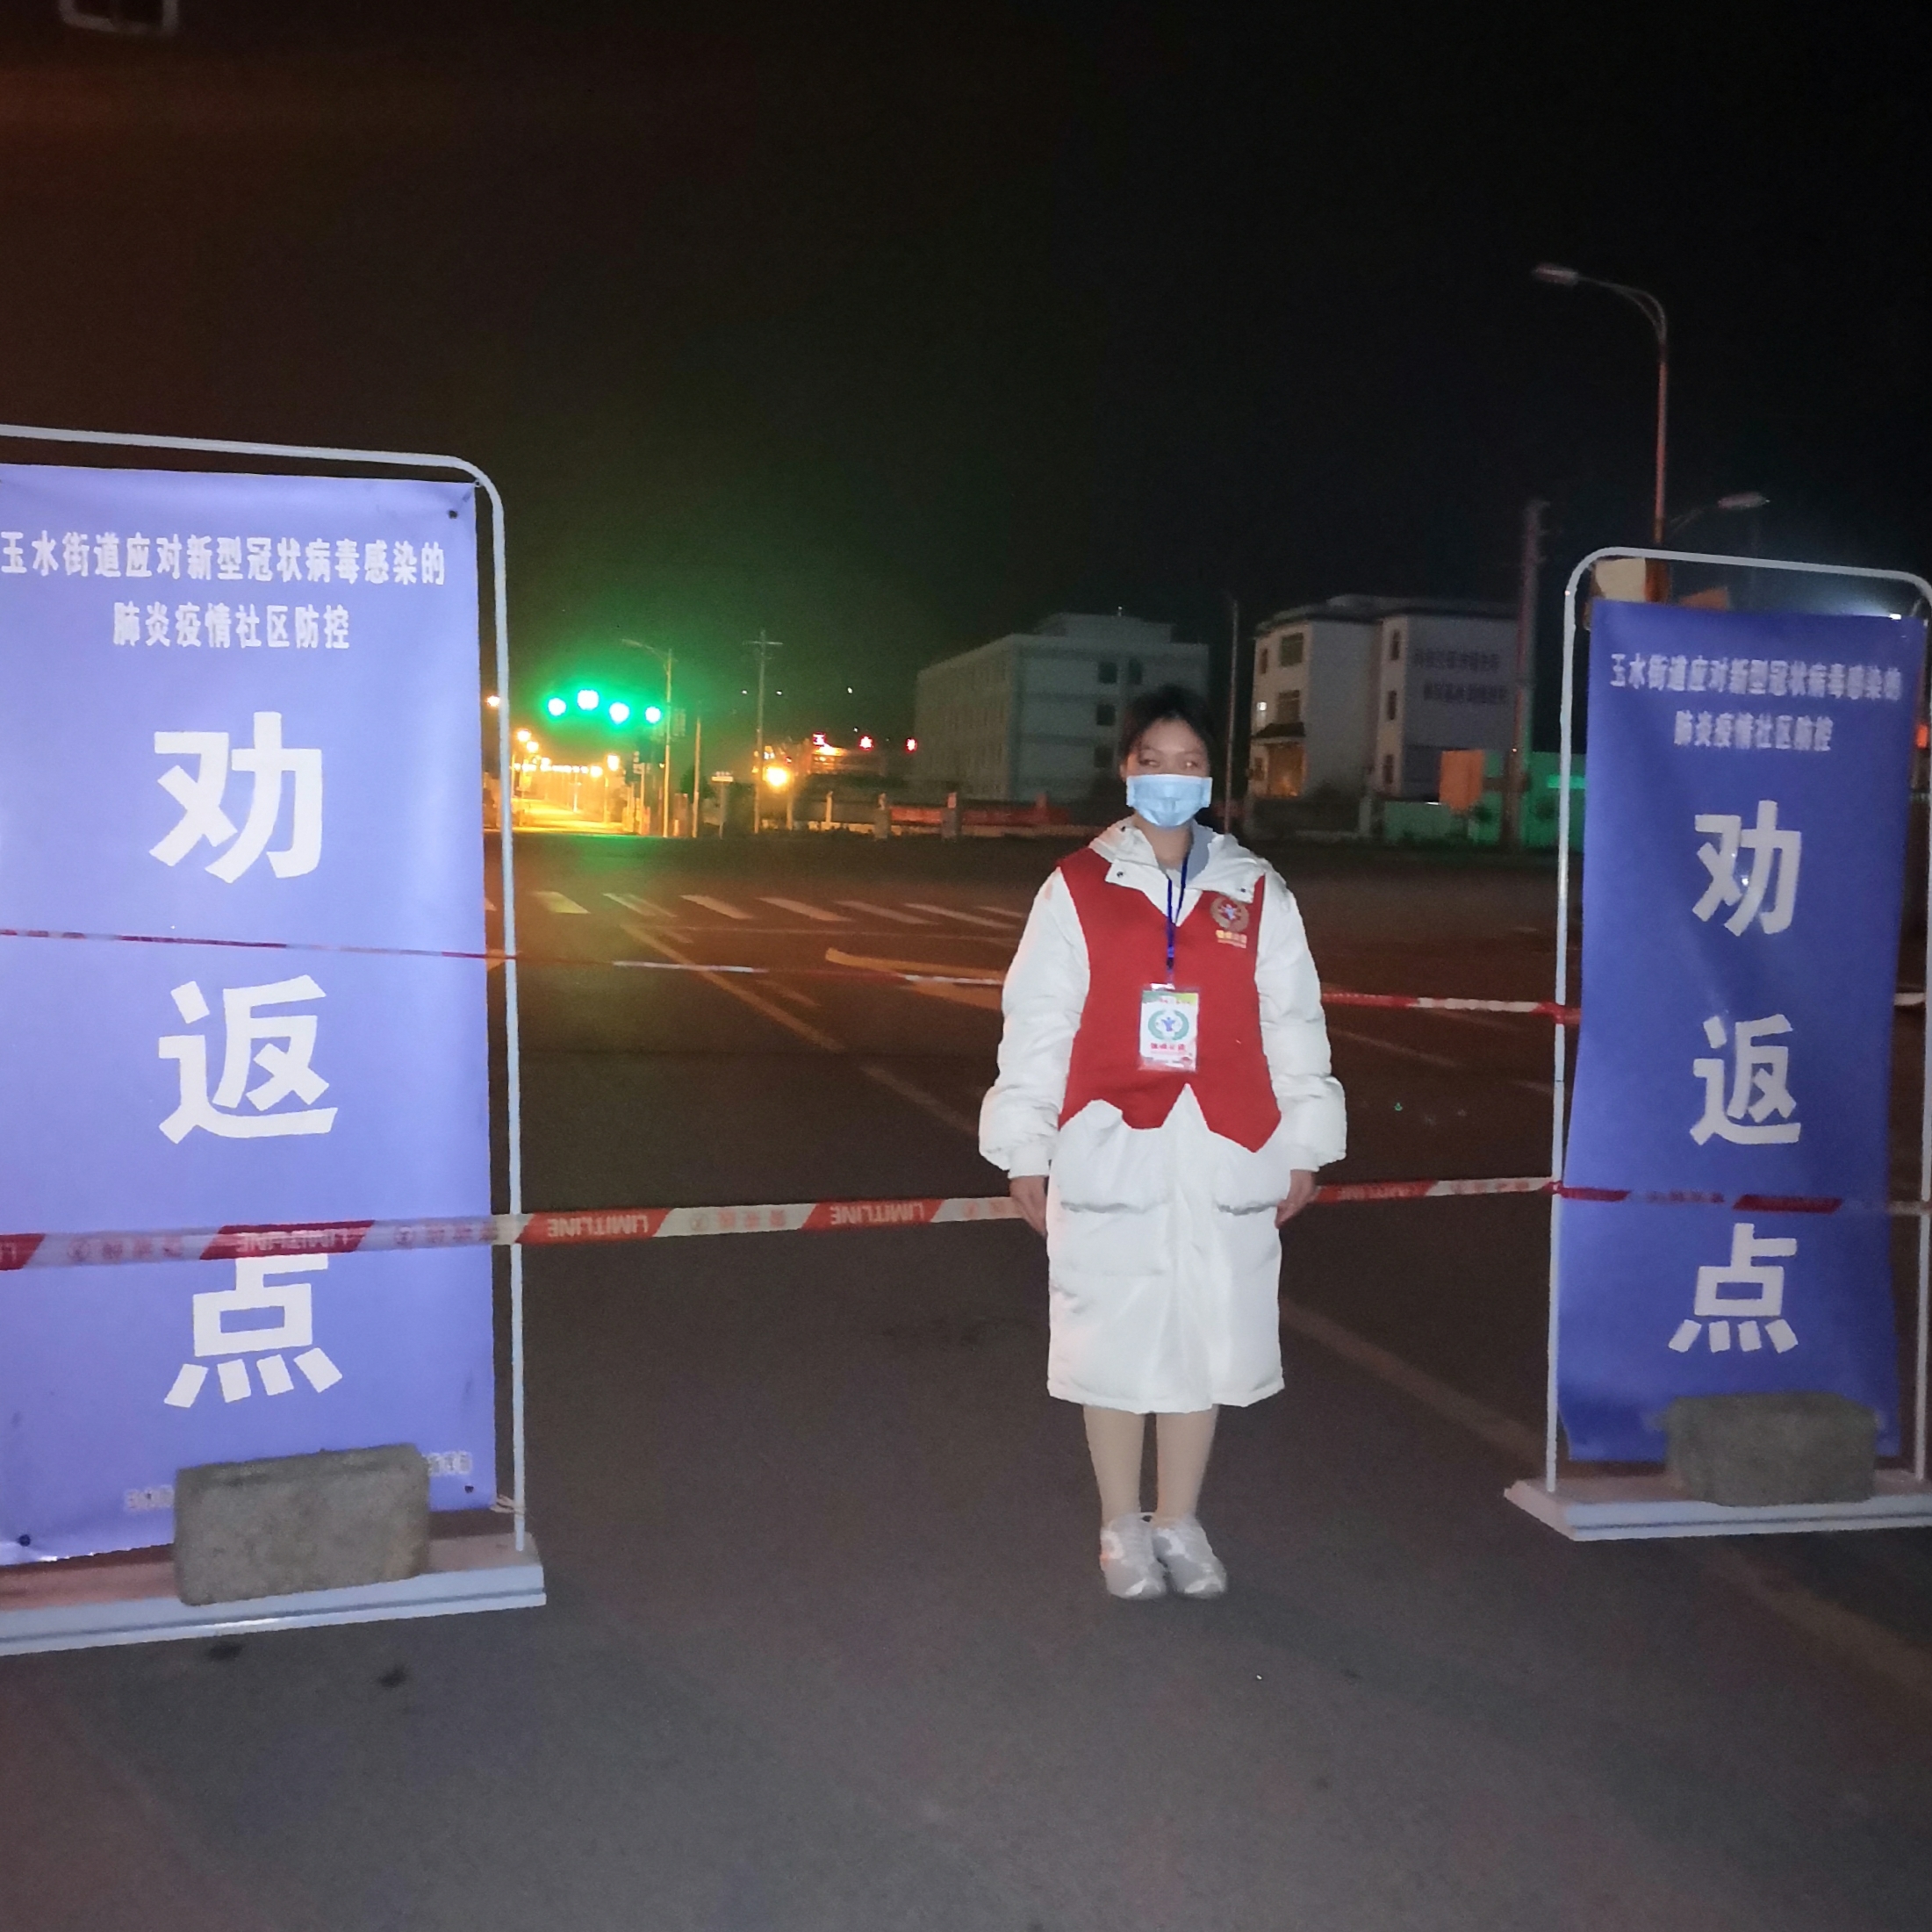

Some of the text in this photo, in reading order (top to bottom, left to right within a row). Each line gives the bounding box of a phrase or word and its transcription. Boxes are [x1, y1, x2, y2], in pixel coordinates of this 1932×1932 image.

[0, 530, 445, 585] 玉水街道应对新型冠状病毒感染的
[113, 601, 350, 649] 肺炎疫情社区防控
